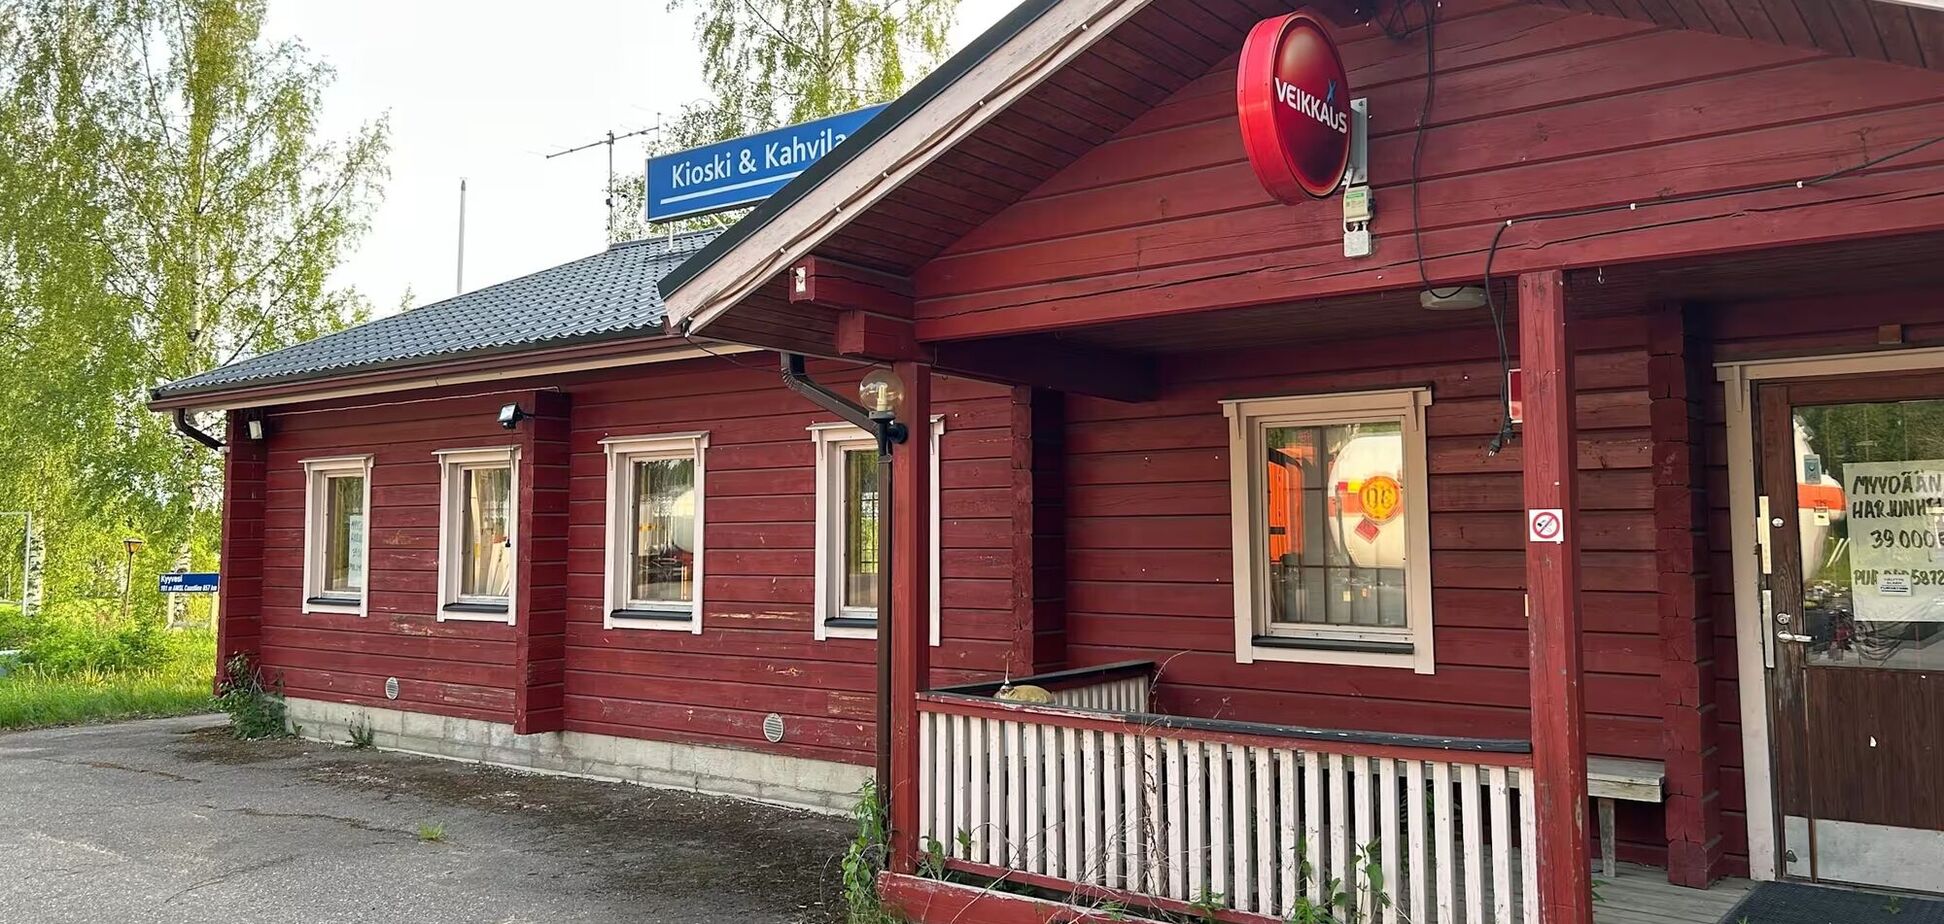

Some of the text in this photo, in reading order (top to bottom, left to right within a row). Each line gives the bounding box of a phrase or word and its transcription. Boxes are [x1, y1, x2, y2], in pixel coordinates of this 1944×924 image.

[1274, 77, 1348, 134] VEIKKAUS
[672, 152, 732, 189] Kioski
[738, 149, 757, 175] &
[1852, 470, 1942, 495] MYYDÄÄN
[161, 575, 182, 584] Kyyvesi
